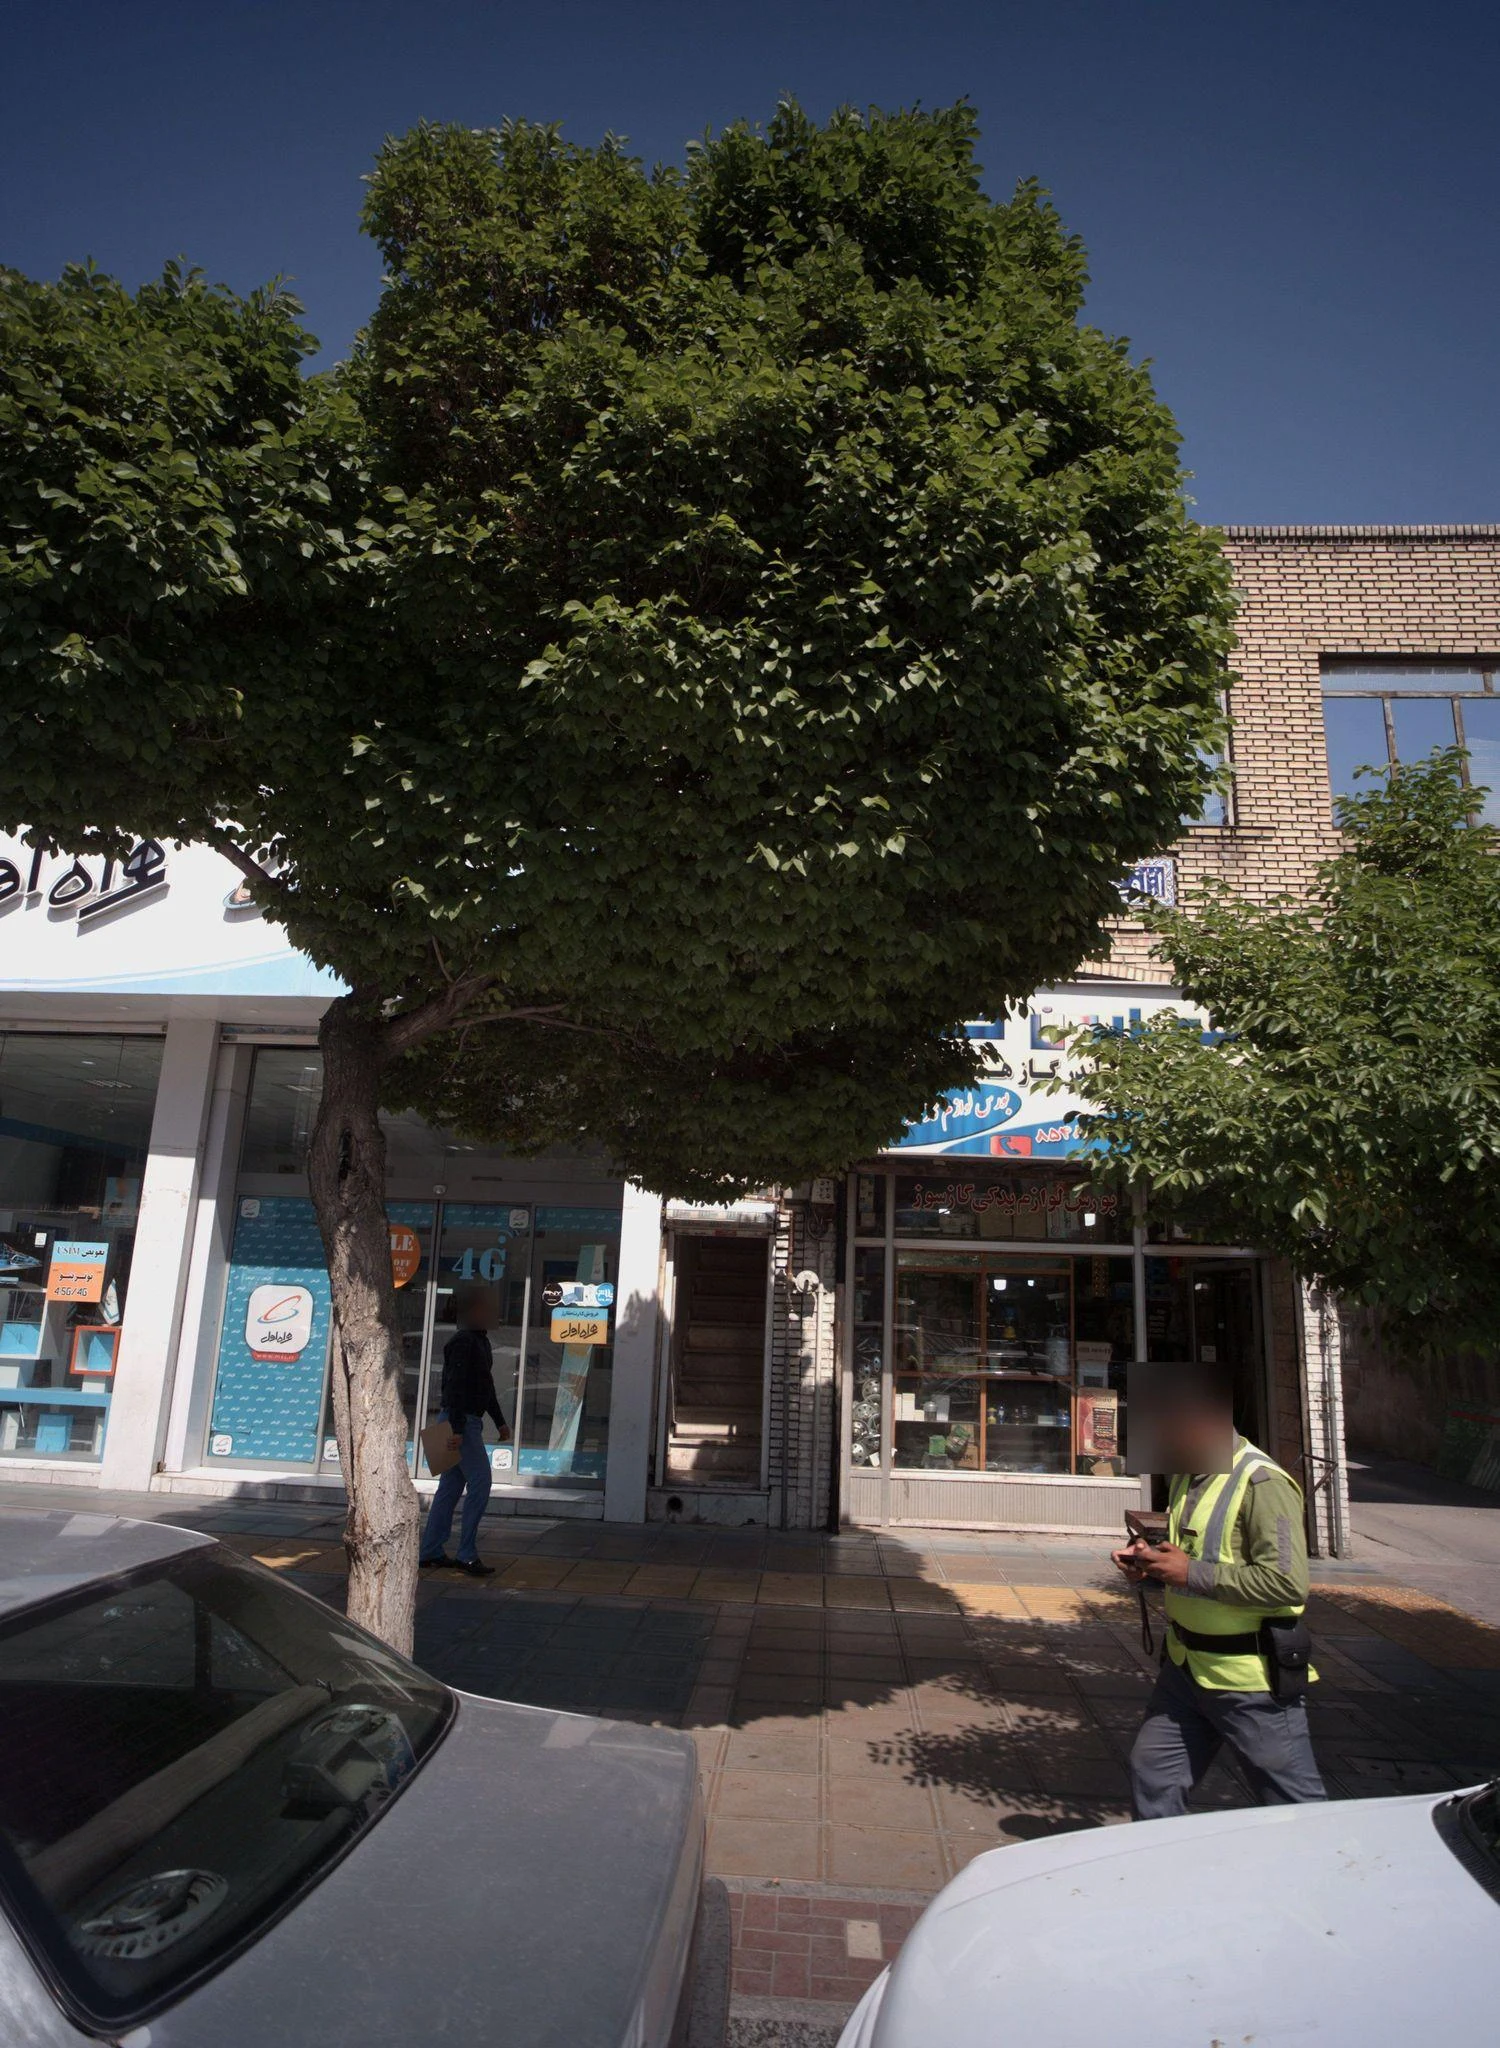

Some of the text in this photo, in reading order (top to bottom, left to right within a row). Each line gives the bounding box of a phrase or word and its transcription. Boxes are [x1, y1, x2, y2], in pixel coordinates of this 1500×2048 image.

[1017, 1055, 1061, 1087] گاز
[974, 1091, 1013, 1119] بورس
[971, 1185, 1016, 1216] یدکی
[1017, 1182, 1065, 1216] لوازم
[1063, 1192, 1118, 1217] بورس
[390, 1233, 414, 1251] LE
[451, 1247, 507, 1281] 4G
[260, 1330, 293, 1345] همراه اول
[559, 1322, 598, 1340] همراه اول
